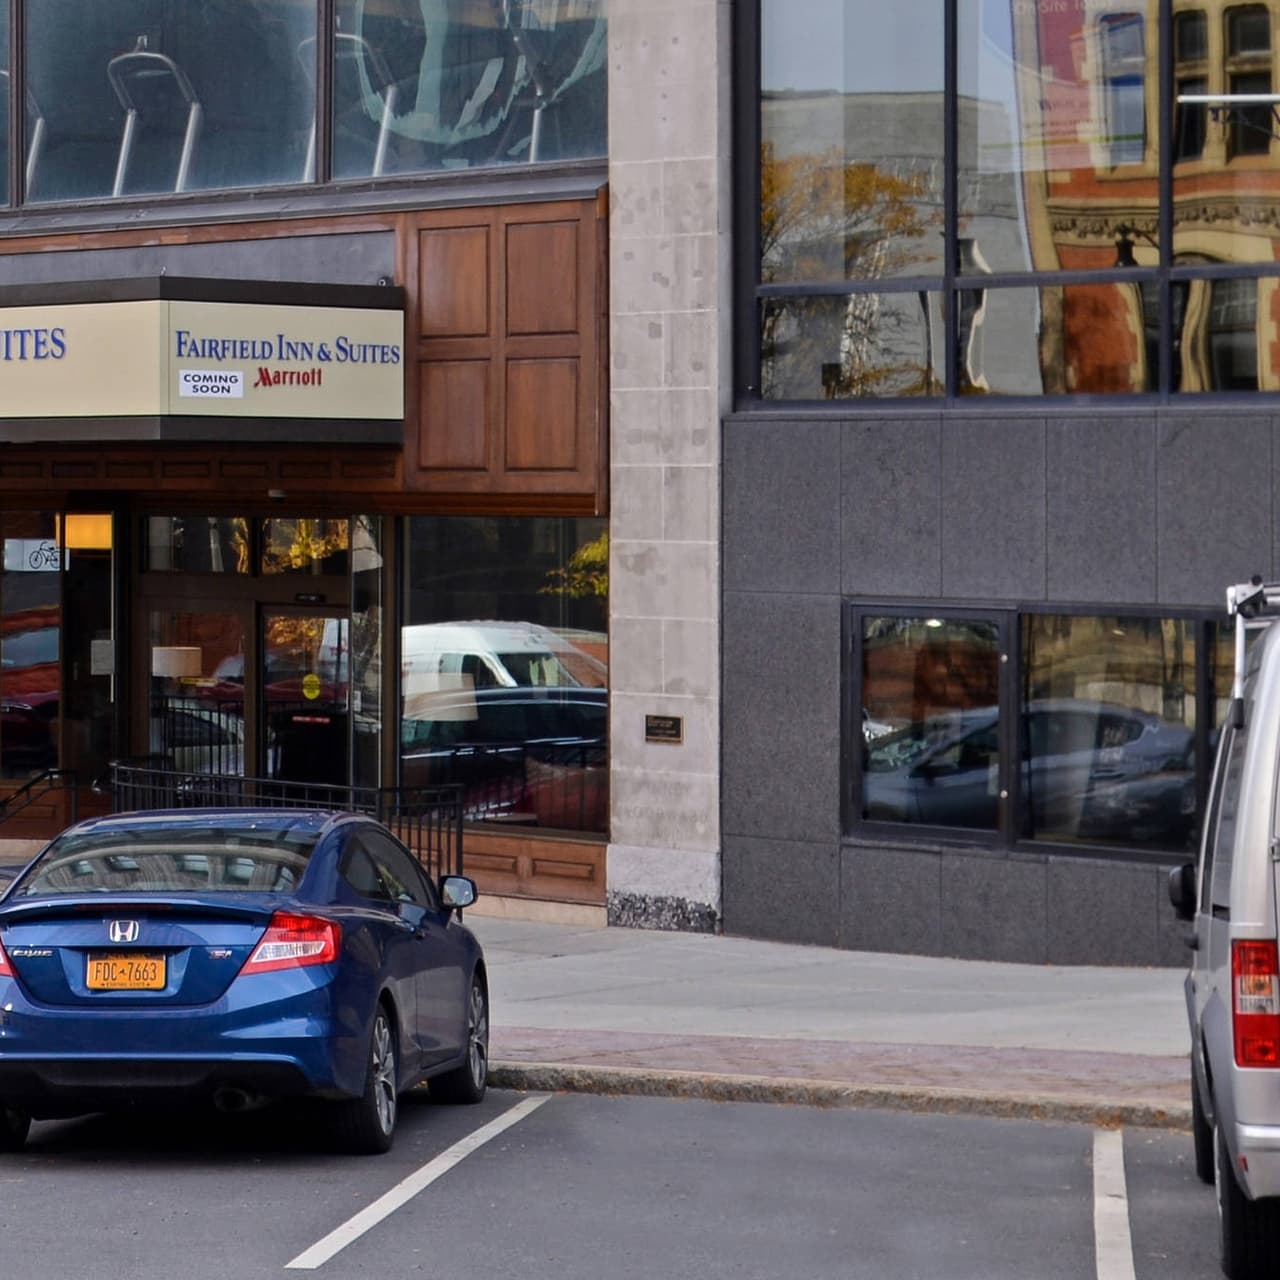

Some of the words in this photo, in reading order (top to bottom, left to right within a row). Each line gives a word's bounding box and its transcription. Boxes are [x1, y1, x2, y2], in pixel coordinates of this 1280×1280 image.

[175, 330, 274, 362] FAIRFIELD
[276, 334, 314, 362] INN
[316, 342, 333, 363] &
[335, 336, 401, 365] SUITES
[183, 373, 239, 385] COMING
[253, 366, 323, 389] Marriott
[191, 384, 231, 394] SOON
